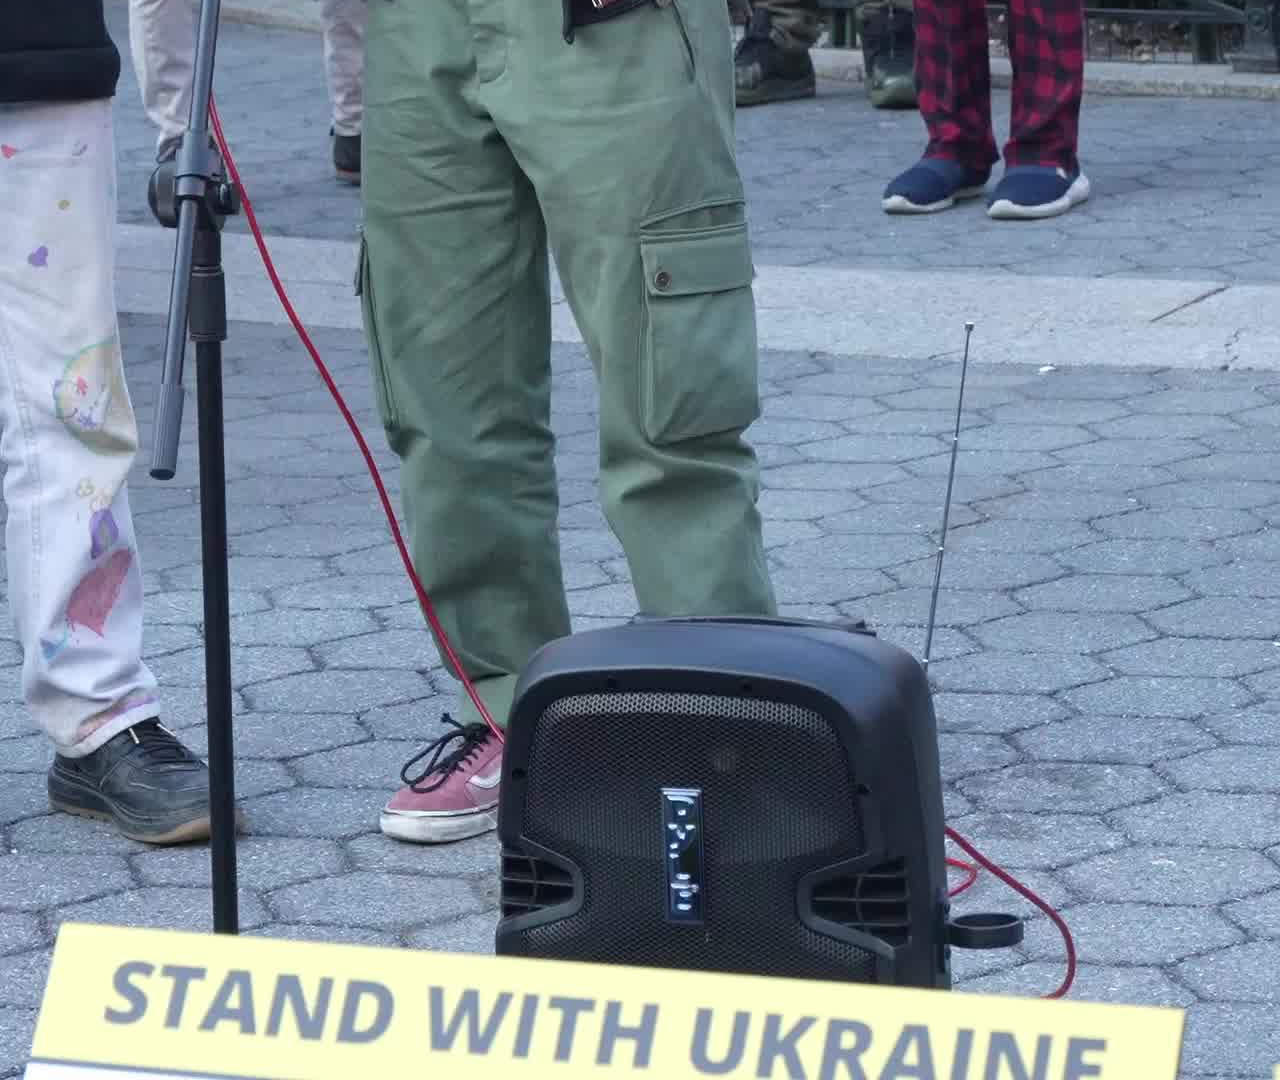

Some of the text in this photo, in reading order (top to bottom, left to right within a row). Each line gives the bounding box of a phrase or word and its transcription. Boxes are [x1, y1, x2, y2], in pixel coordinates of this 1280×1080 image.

[104, 961, 1108, 1080] STAND WITH UKRAINE
